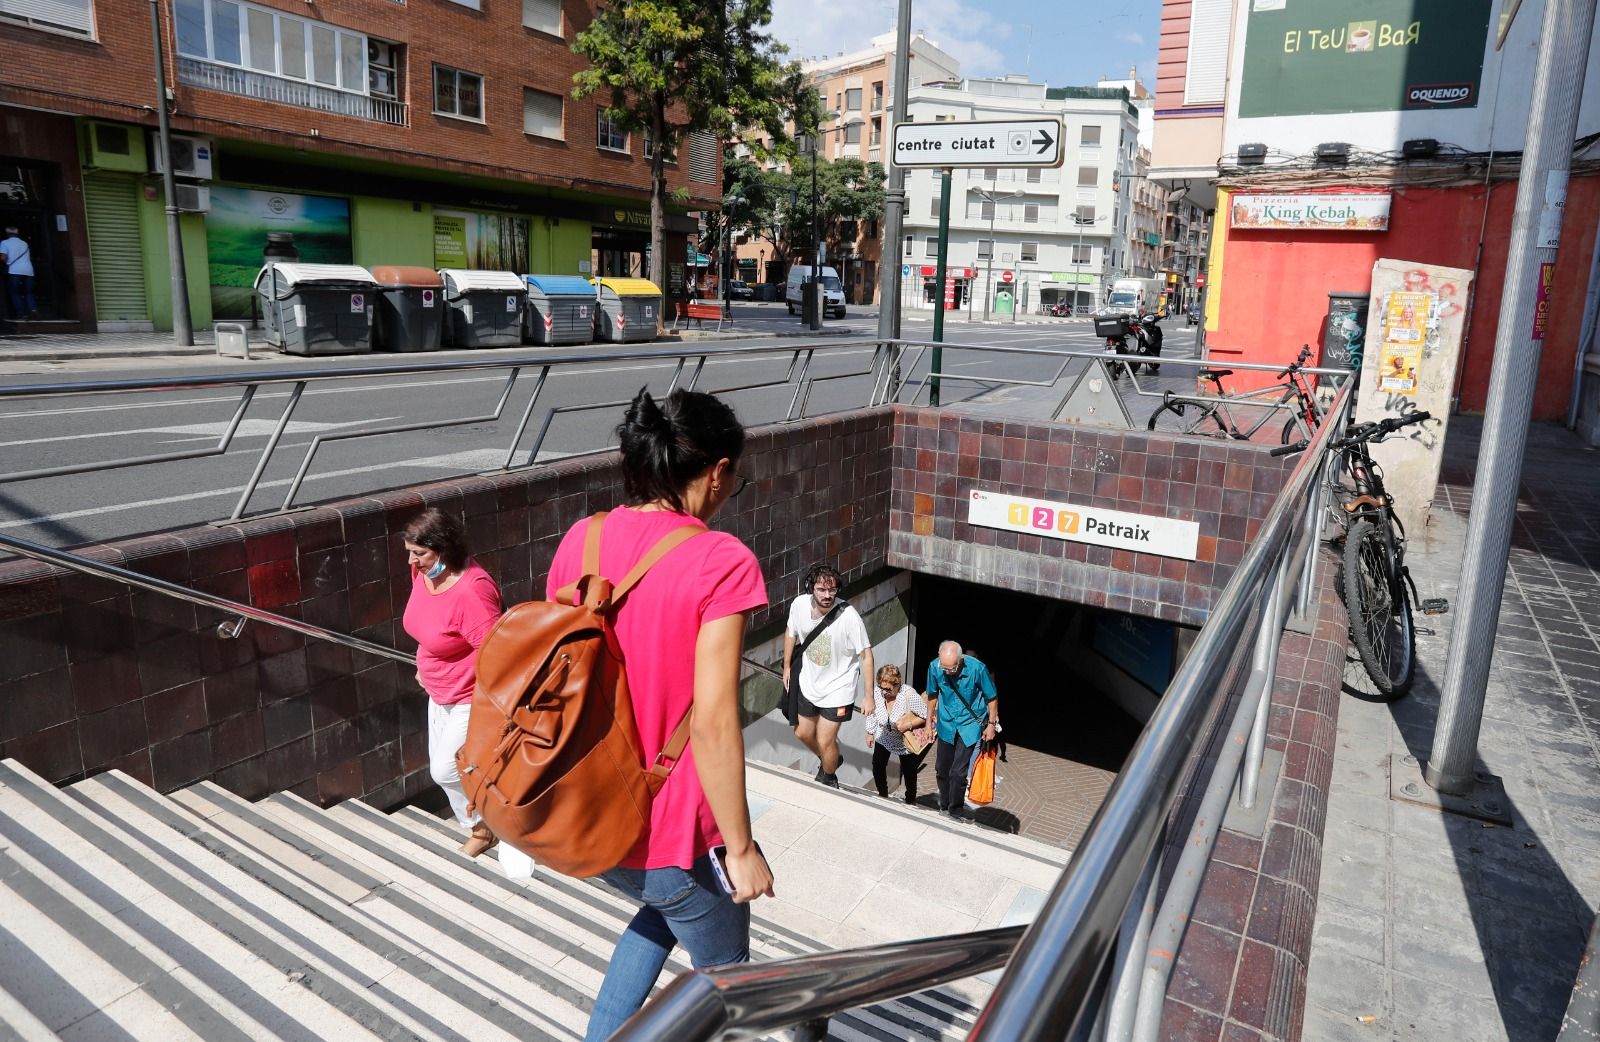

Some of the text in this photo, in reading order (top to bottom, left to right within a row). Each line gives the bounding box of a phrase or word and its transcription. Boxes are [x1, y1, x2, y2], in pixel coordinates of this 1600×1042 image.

[1284, 31, 1301, 53] El
[1410, 87, 1469, 102] OQUENDO
[897, 136, 995, 151] centre ciutat
[1252, 196, 1299, 204] Pizzeria
[1263, 205, 1302, 219] King
[1306, 205, 1356, 219] Kebab
[1085, 517, 1150, 542] Patraix
